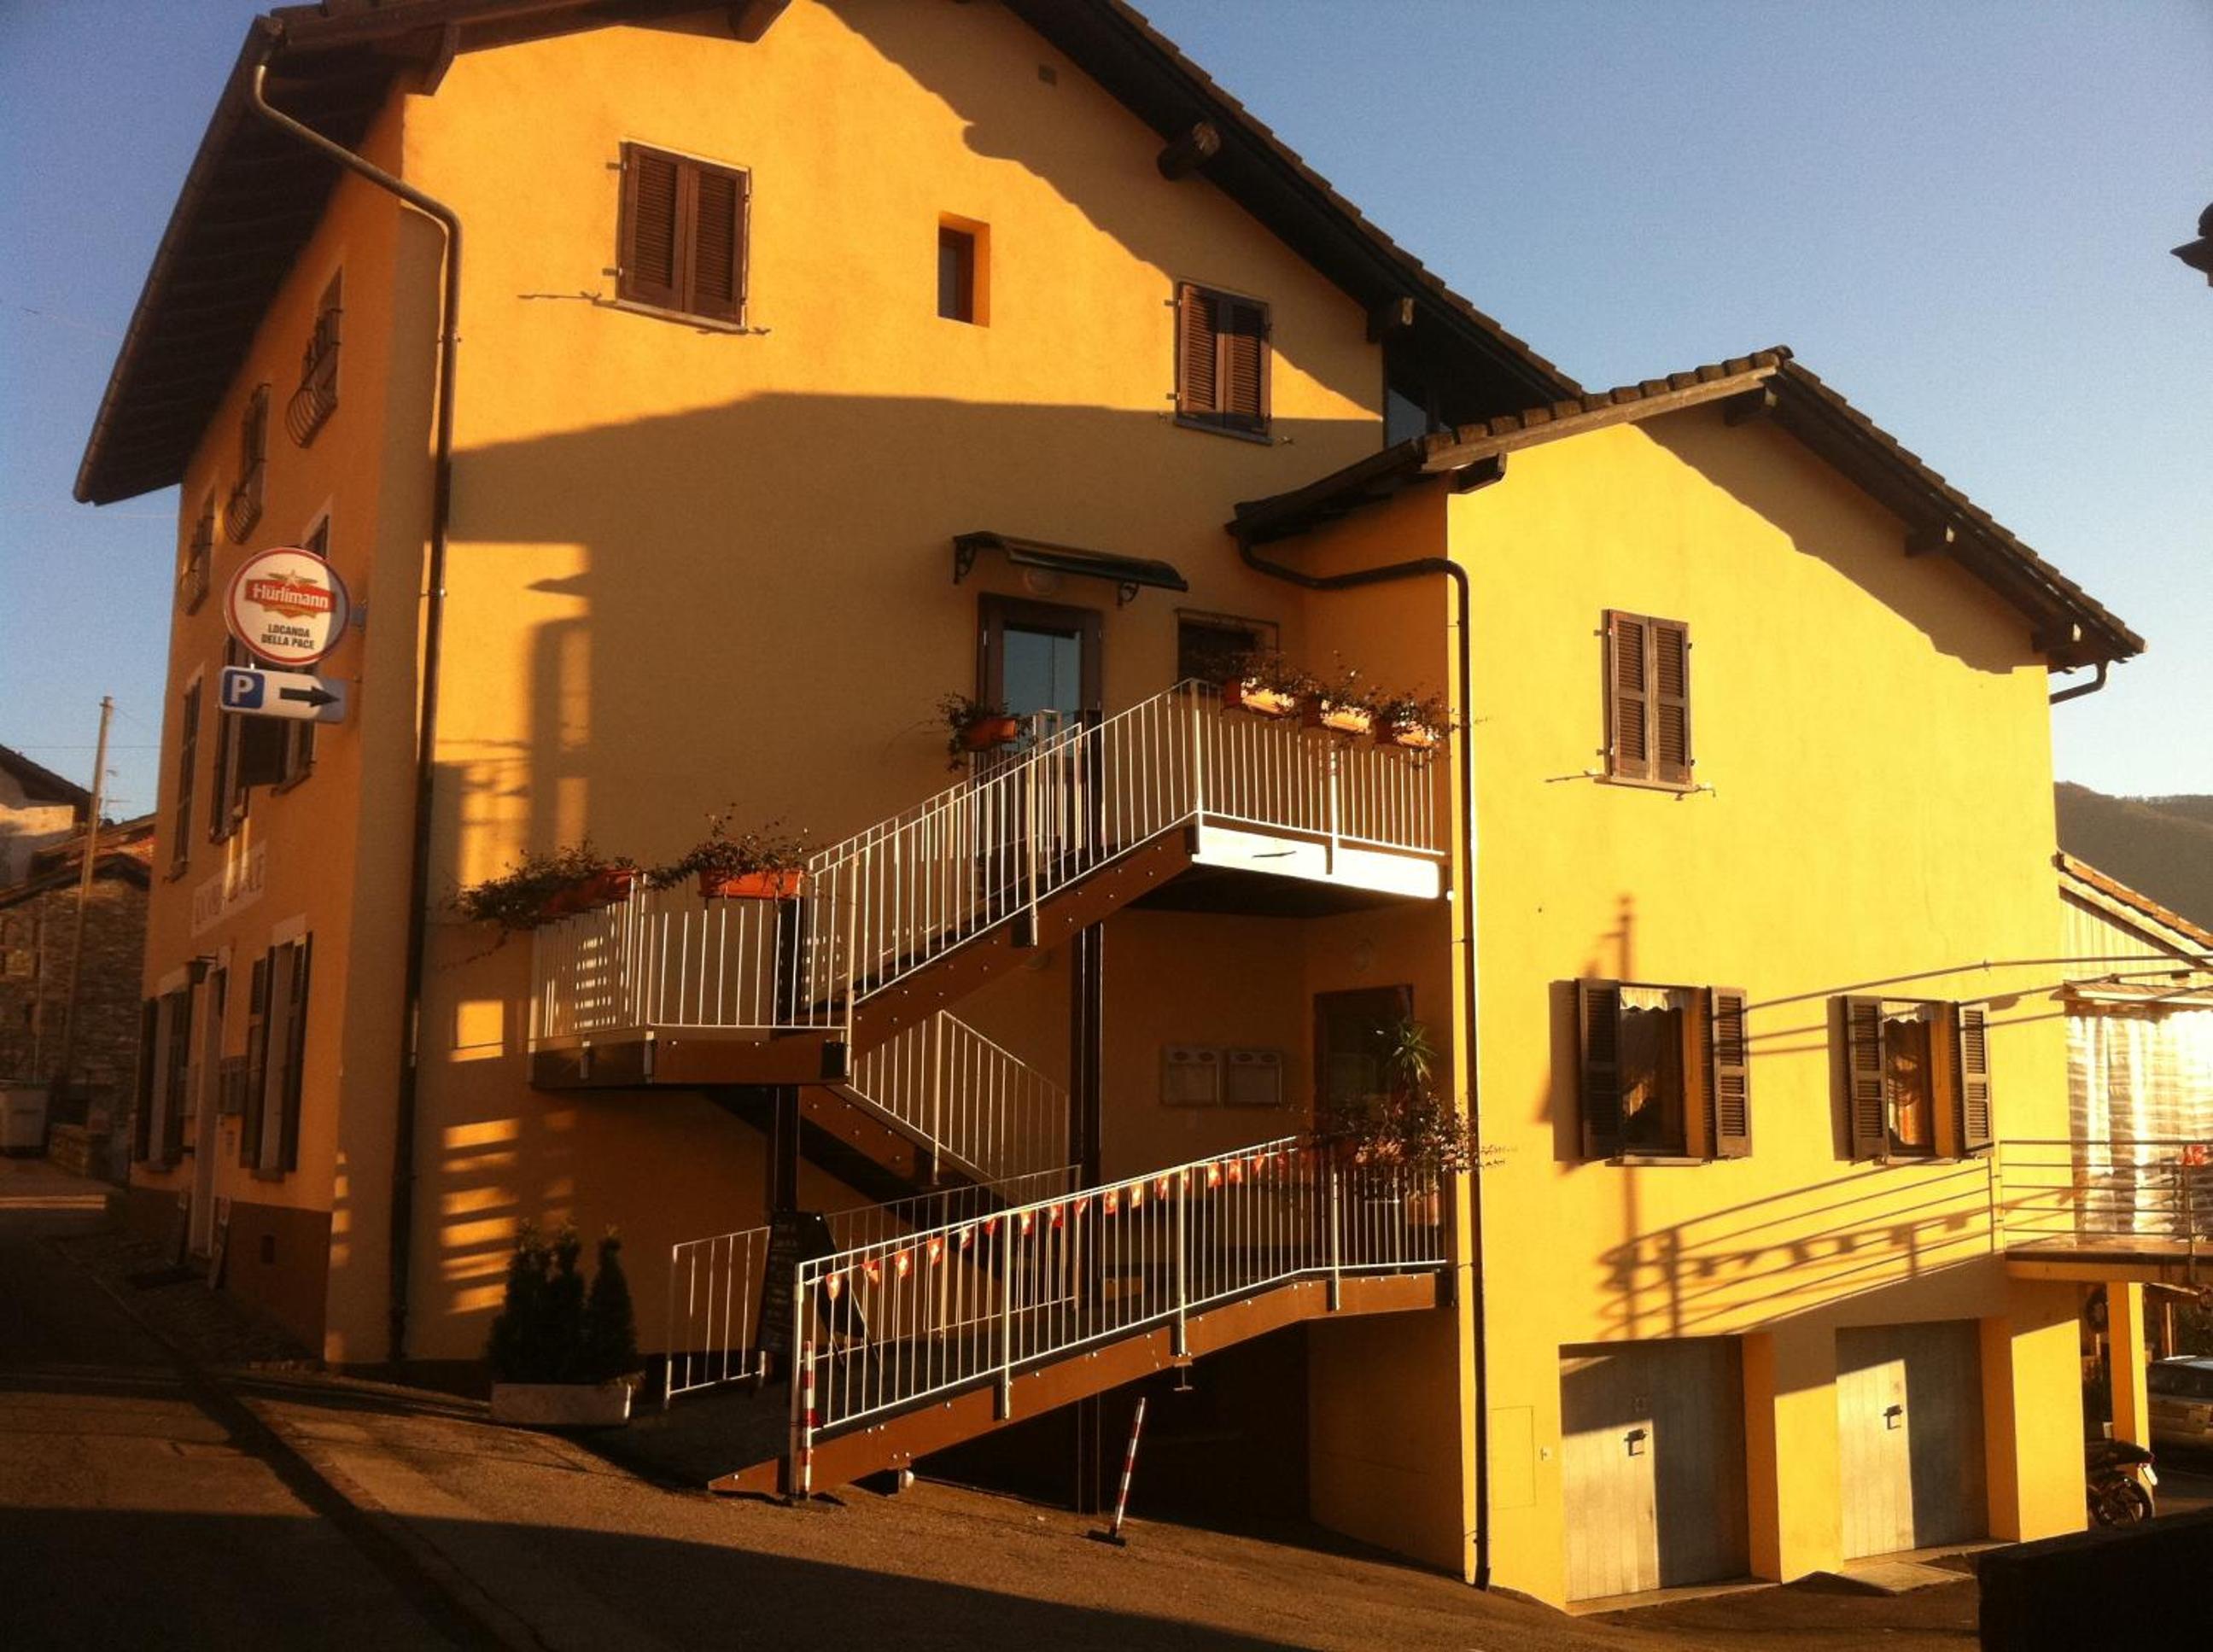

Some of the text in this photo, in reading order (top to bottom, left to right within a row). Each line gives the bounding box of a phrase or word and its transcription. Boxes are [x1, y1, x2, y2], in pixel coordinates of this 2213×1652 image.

[253, 582, 329, 609] Hürlimann
[261, 633, 315, 650] DELLA PACE
[268, 623, 310, 638] LOCANDA
[231, 674, 254, 704] P
